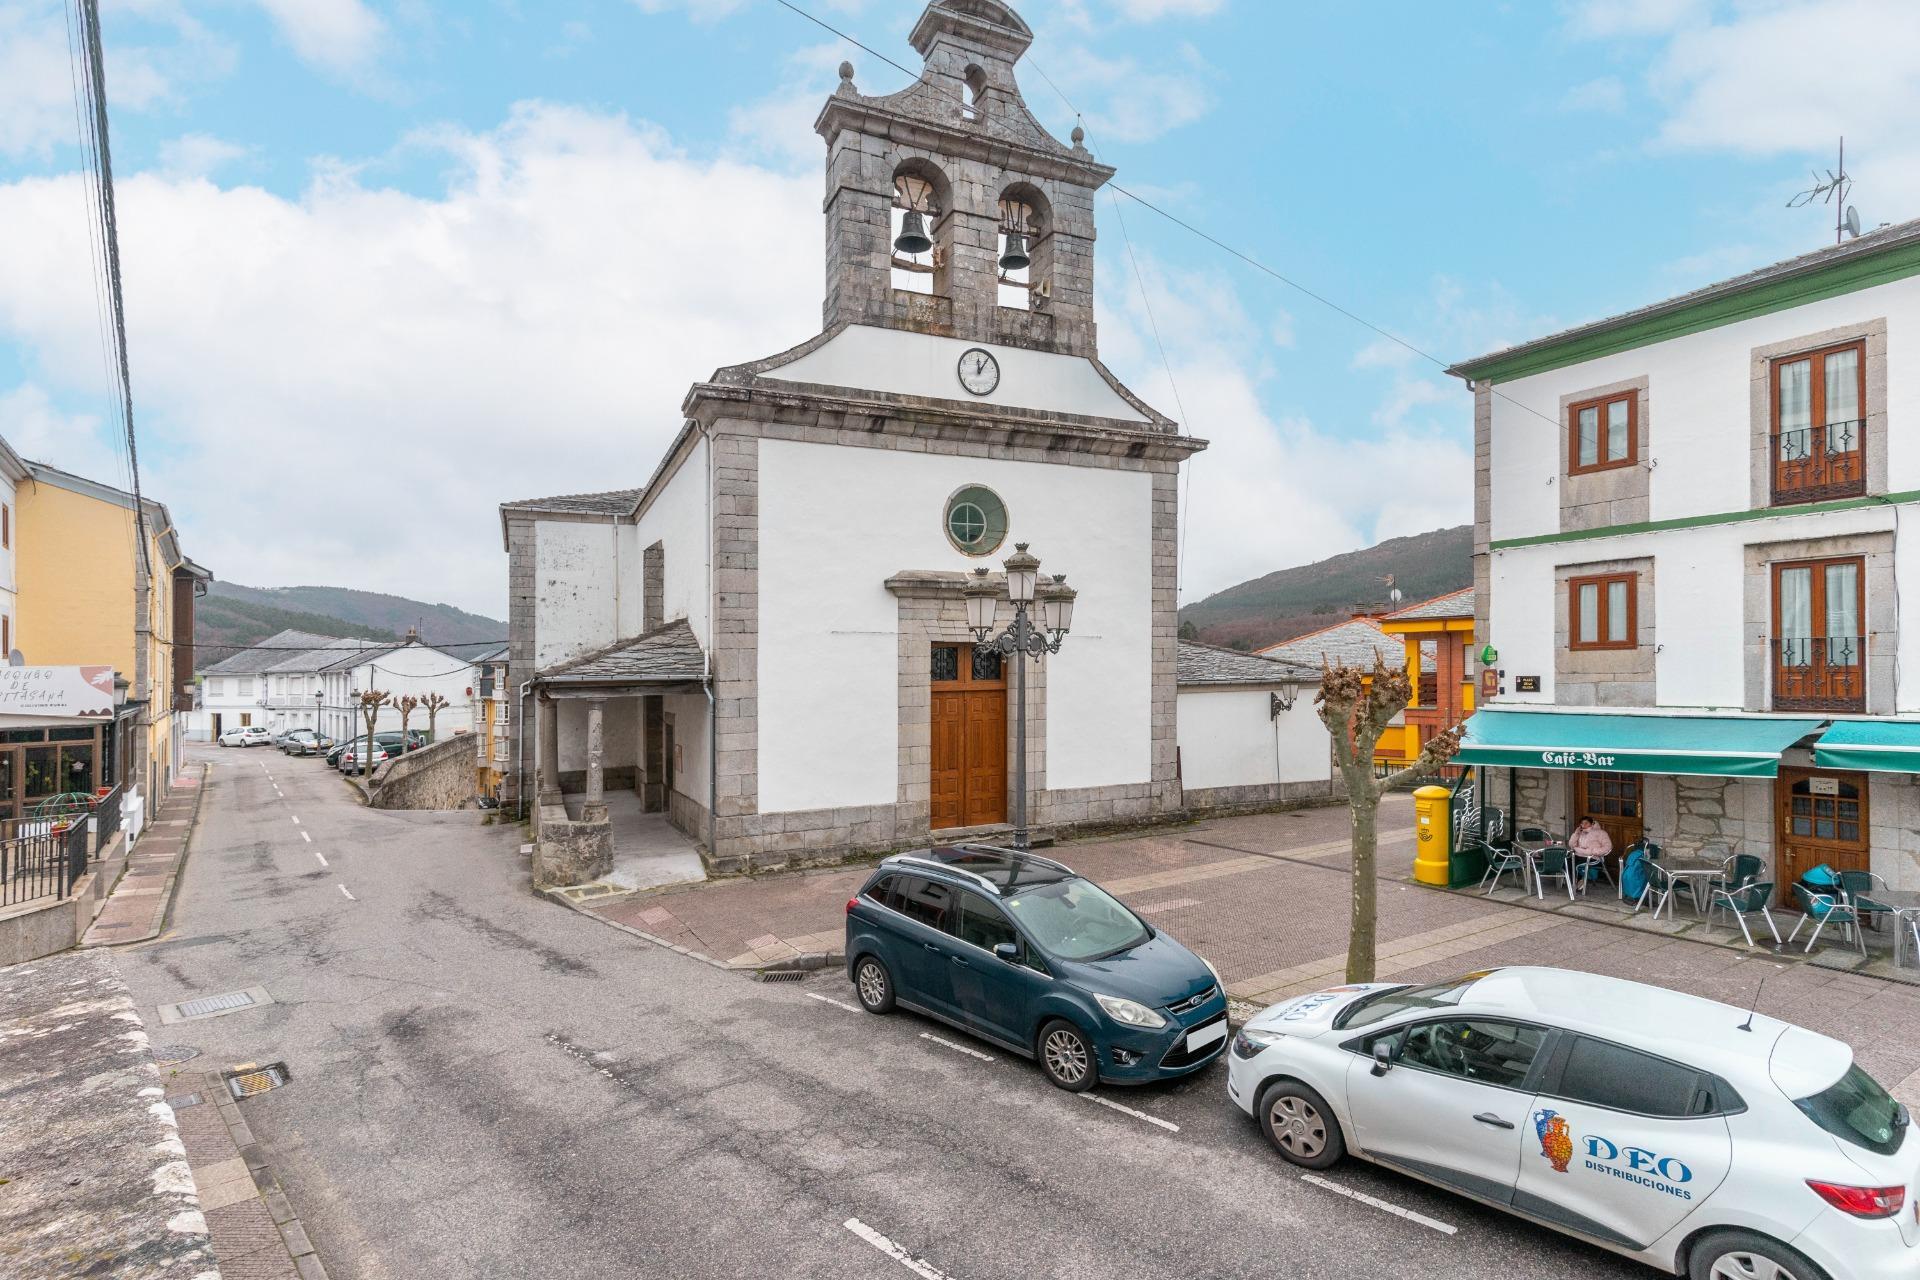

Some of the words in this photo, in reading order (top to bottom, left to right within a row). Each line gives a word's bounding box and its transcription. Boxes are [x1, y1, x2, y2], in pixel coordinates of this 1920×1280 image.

[10, 681, 30, 690] DE
[1542, 751, 1615, 767] Café-Bar
[1582, 1134, 1693, 1183] DEO
[1585, 1160, 1692, 1200] DISTRIBUCIONES
